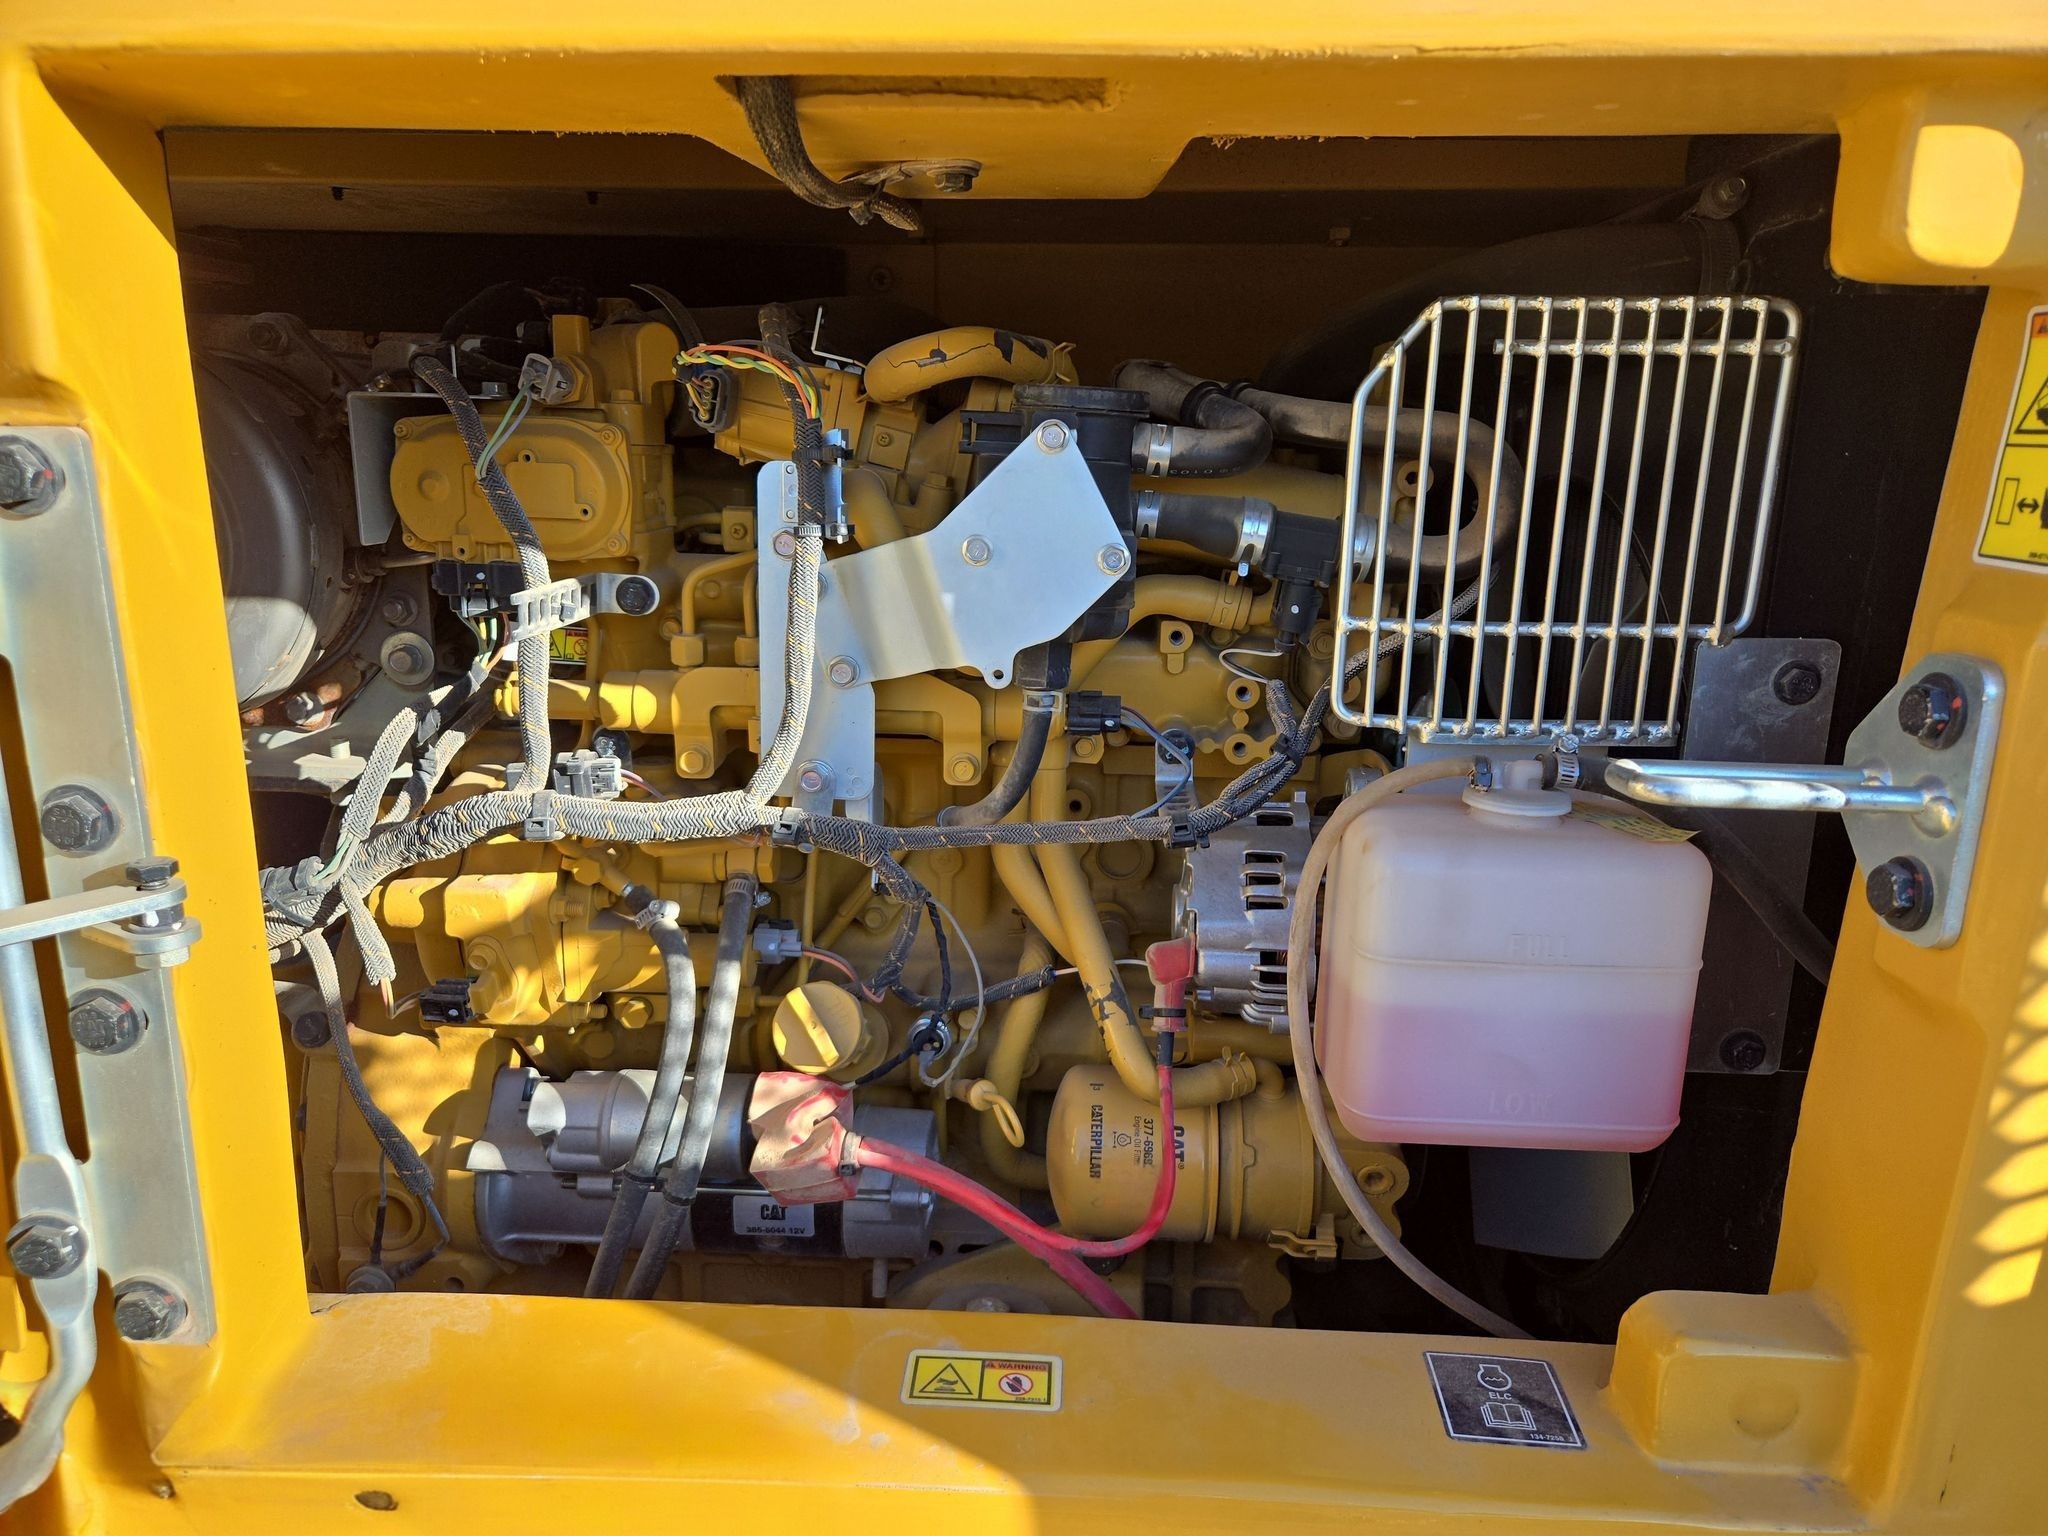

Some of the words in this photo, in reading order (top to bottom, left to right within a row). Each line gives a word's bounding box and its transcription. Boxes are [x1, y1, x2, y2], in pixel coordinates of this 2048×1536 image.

[1133, 1115, 1142, 1137] Engine
[1089, 1104, 1104, 1178] CATERPILLAR
[760, 1204, 788, 1220] CAT
[789, 1227, 806, 1235] 12V
[999, 1362, 1047, 1371] WARNING
[1489, 1391, 1513, 1401] ELC
